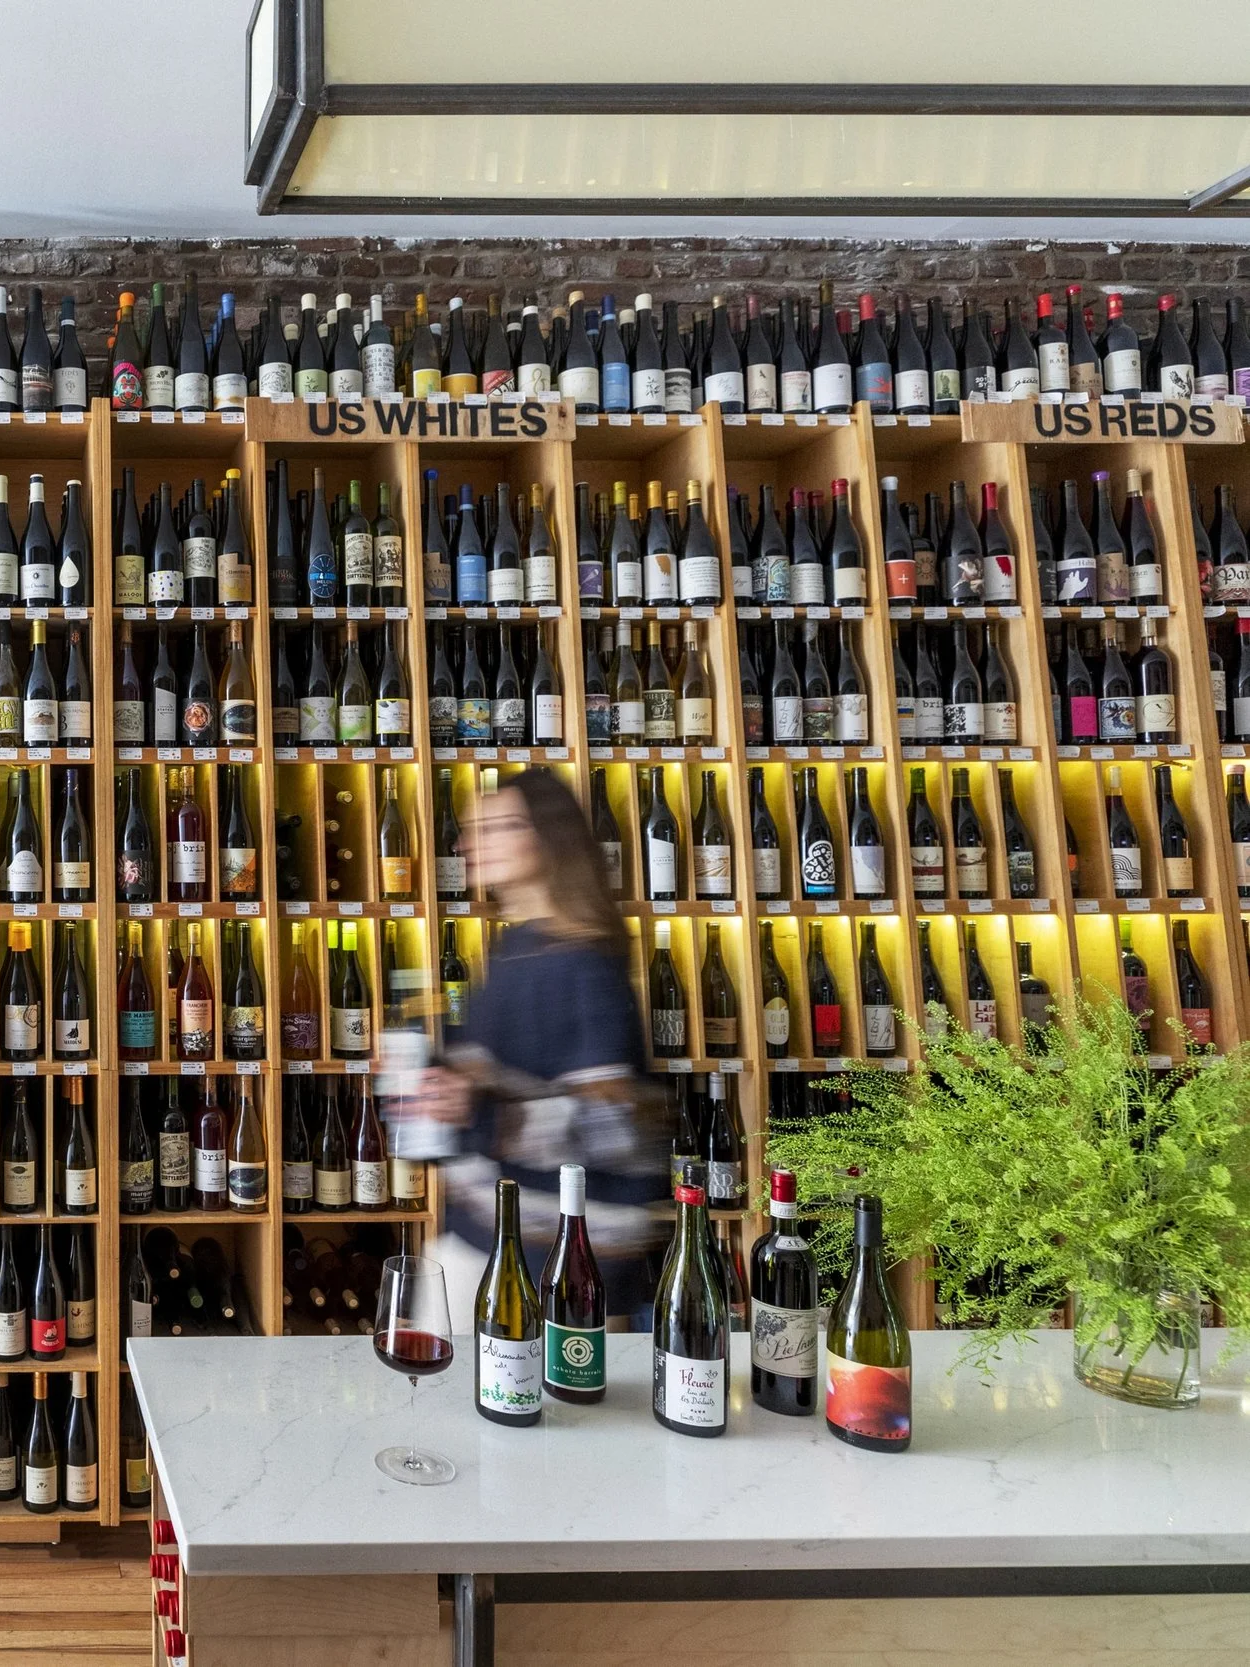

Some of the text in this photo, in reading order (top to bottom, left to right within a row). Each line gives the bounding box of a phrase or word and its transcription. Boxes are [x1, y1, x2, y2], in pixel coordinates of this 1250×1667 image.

[309, 402, 366, 437] US
[374, 401, 548, 437] WHITES
[1034, 403, 1093, 437] US
[1101, 402, 1216, 438] REDS
[679, 1367, 715, 1389] Fleurie
